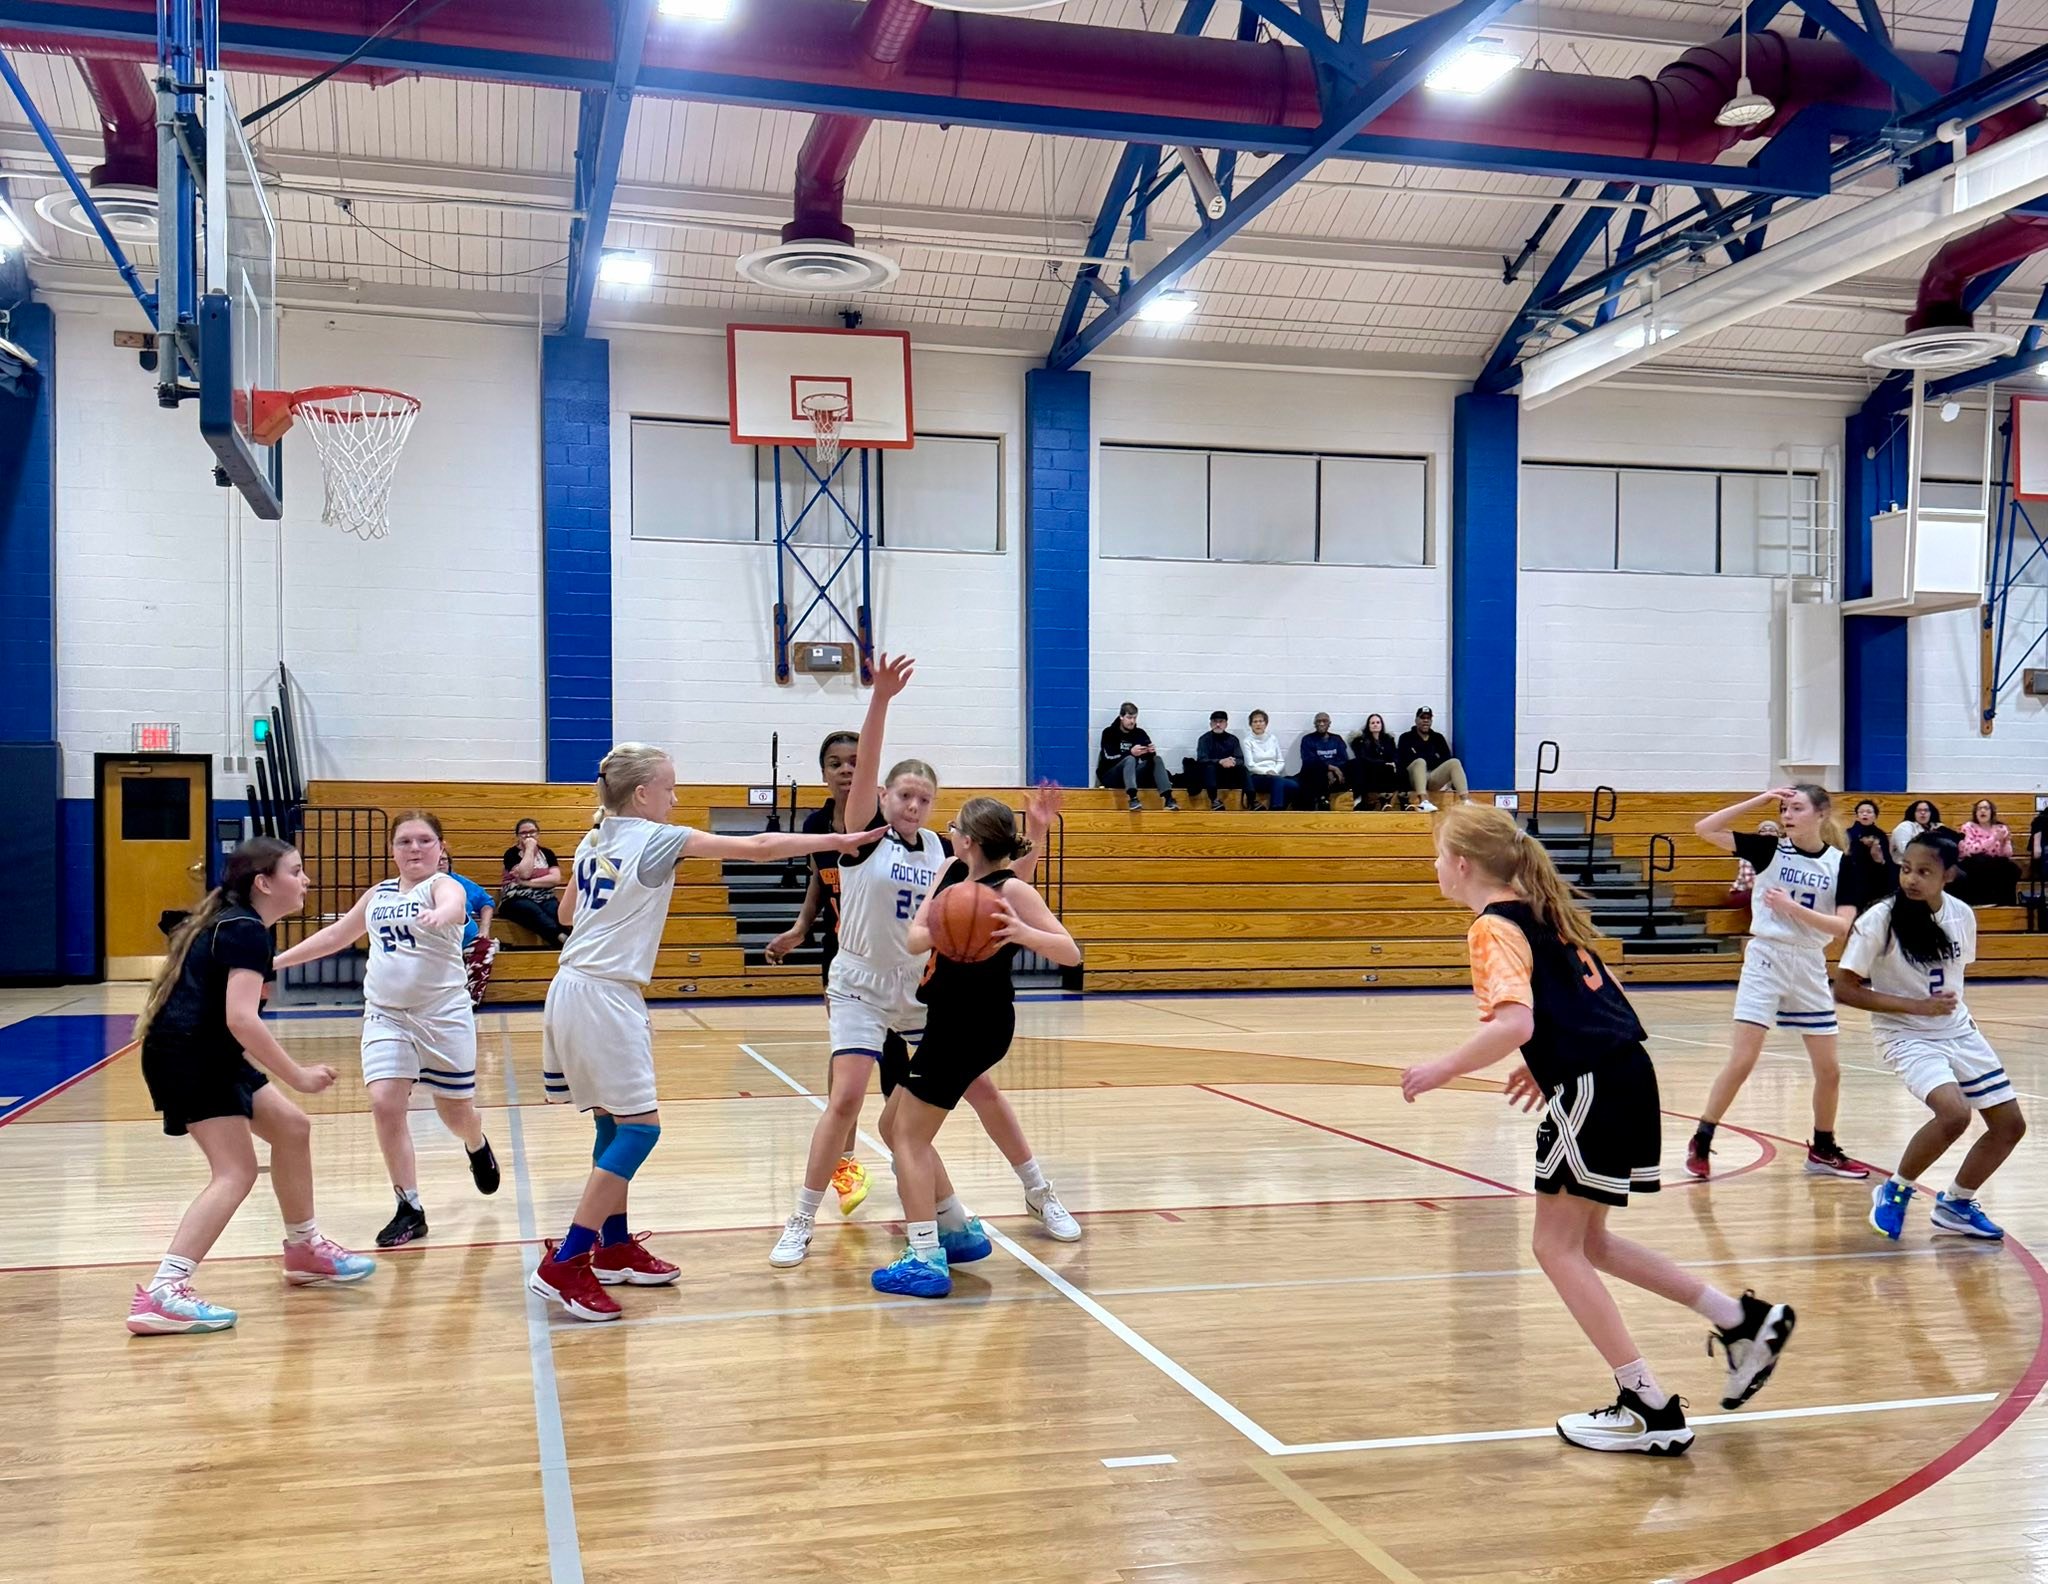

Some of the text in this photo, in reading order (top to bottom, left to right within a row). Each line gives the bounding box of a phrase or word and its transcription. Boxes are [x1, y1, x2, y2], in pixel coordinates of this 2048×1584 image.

[1779, 866, 1831, 890] ROCKETS
[371, 902, 420, 921] ROCKETS
[379, 925, 417, 953] 24
[1929, 968, 1945, 995] 2
